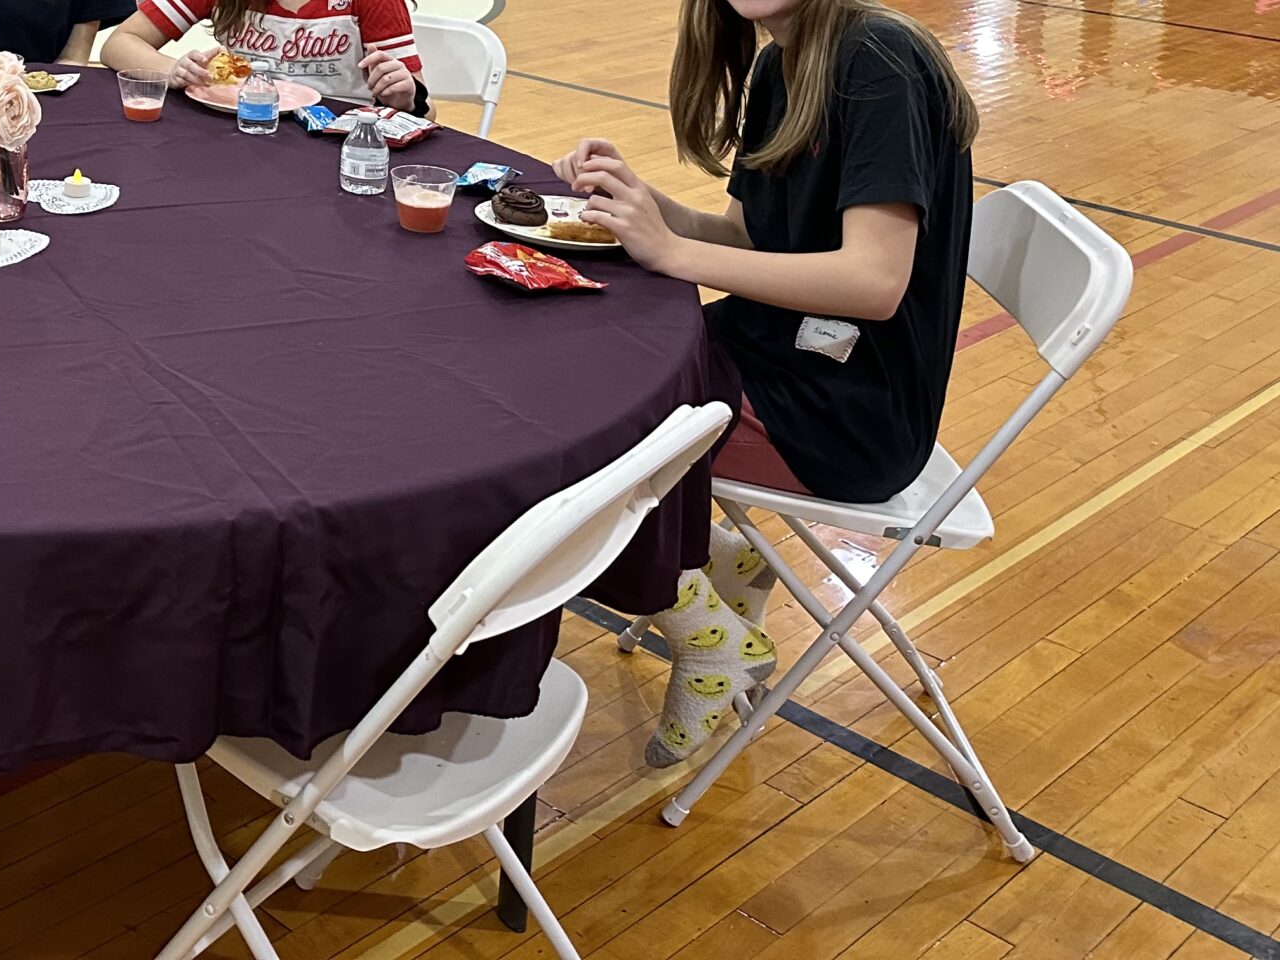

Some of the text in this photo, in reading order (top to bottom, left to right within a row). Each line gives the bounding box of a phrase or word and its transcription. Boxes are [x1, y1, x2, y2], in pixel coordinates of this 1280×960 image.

[227, 22, 351, 63] Ohio State
[251, 57, 338, 74] KEYES
